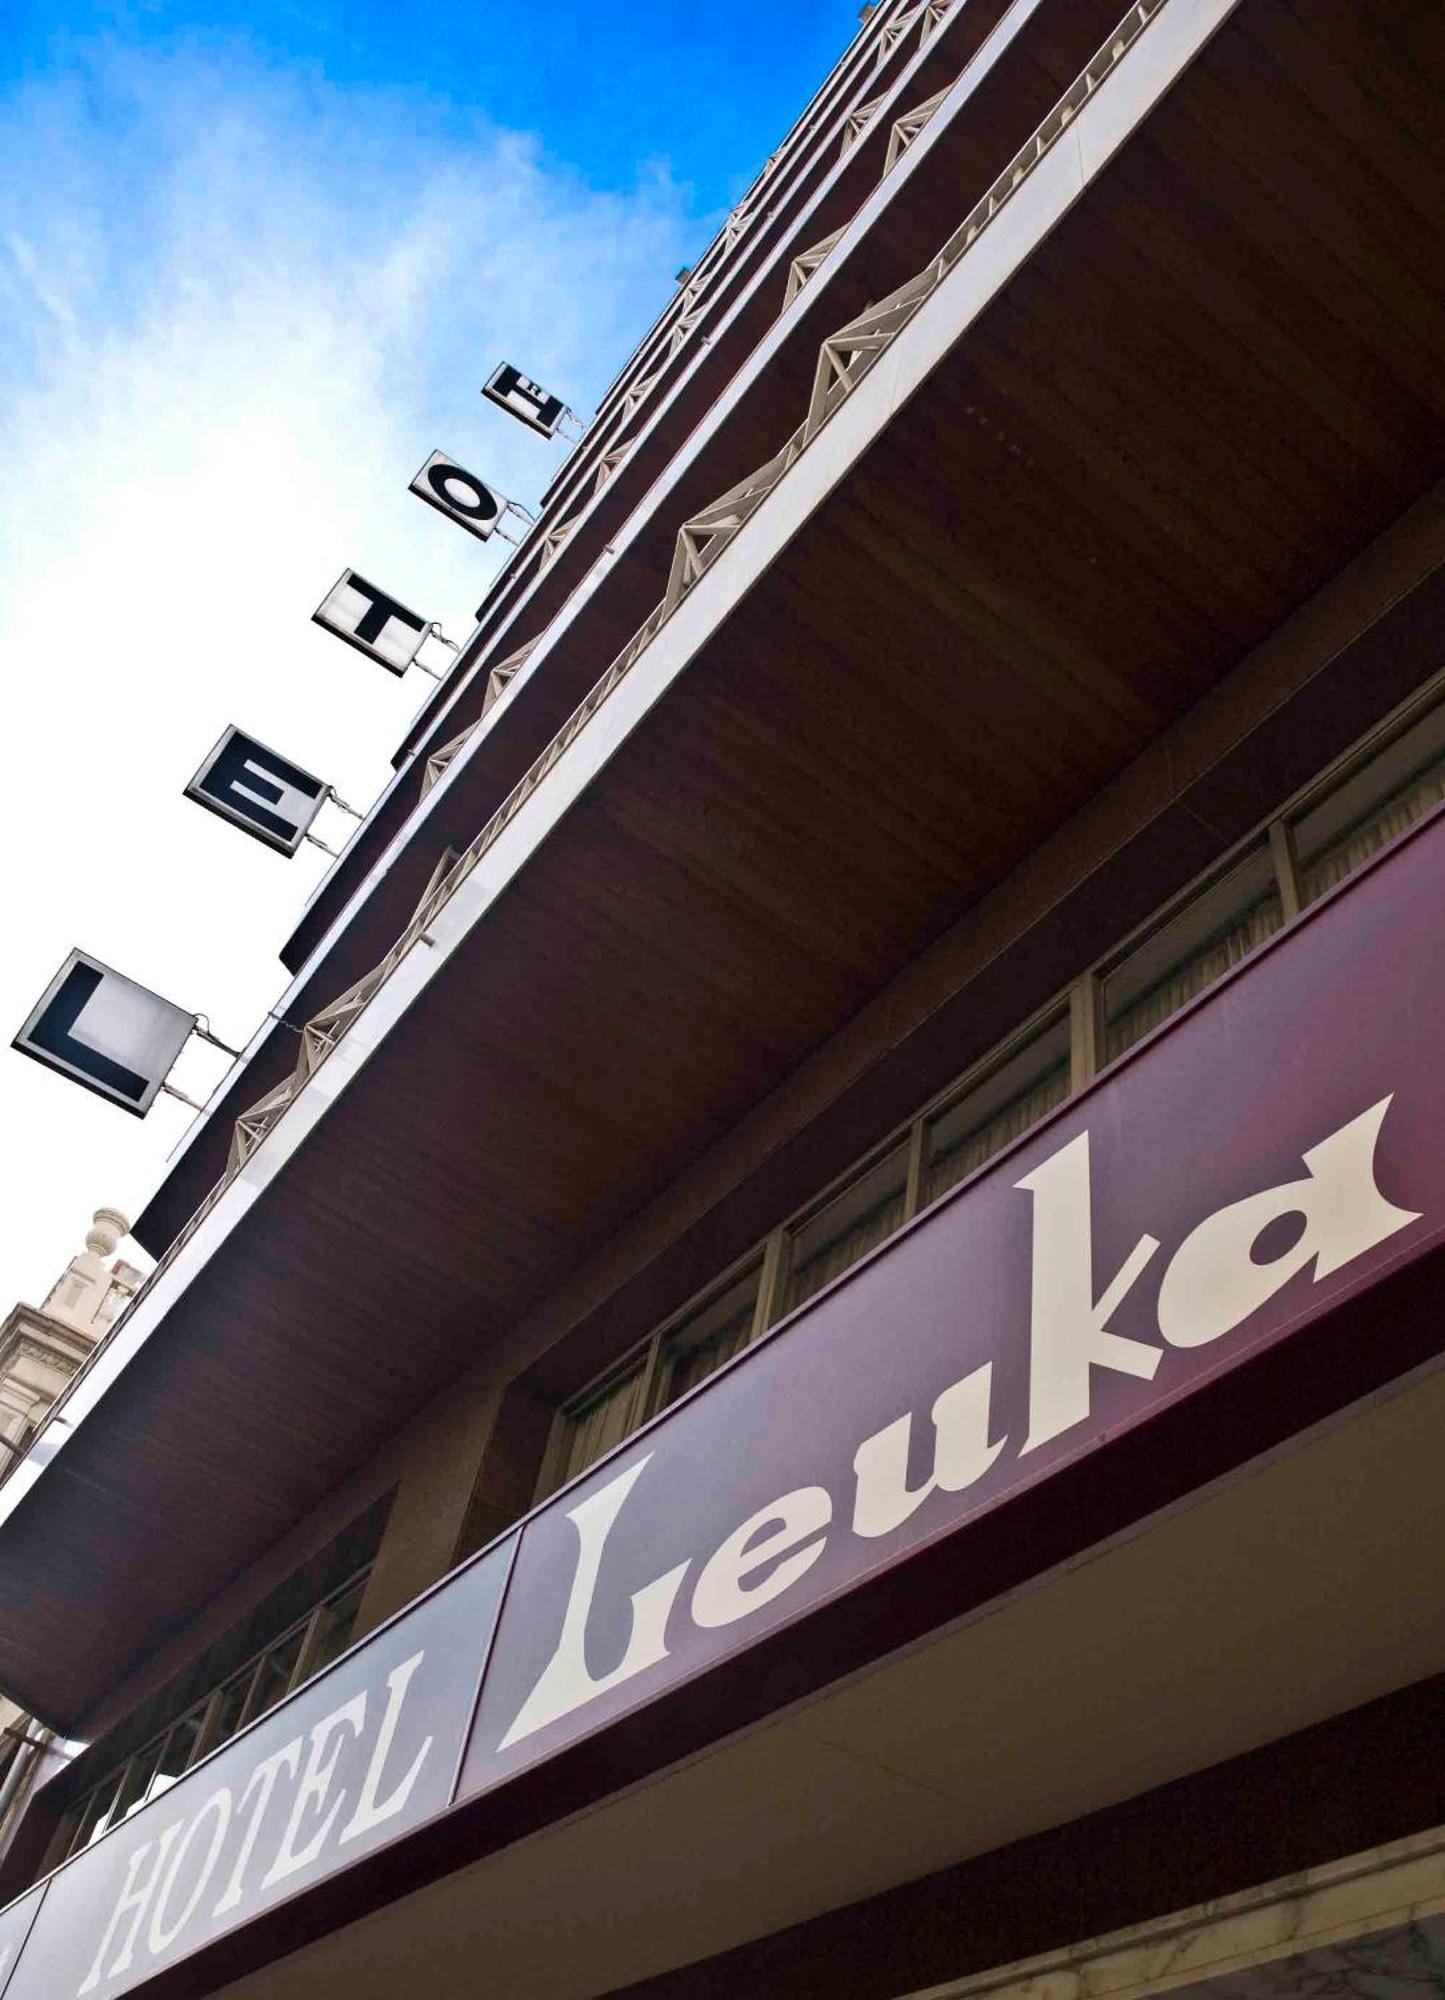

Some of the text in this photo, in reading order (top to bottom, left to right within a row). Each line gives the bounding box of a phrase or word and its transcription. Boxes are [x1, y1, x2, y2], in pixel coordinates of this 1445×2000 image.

[28, 365, 563, 1102] HOTEL
[76, 1093, 1424, 1997] HOTEL Leuka
